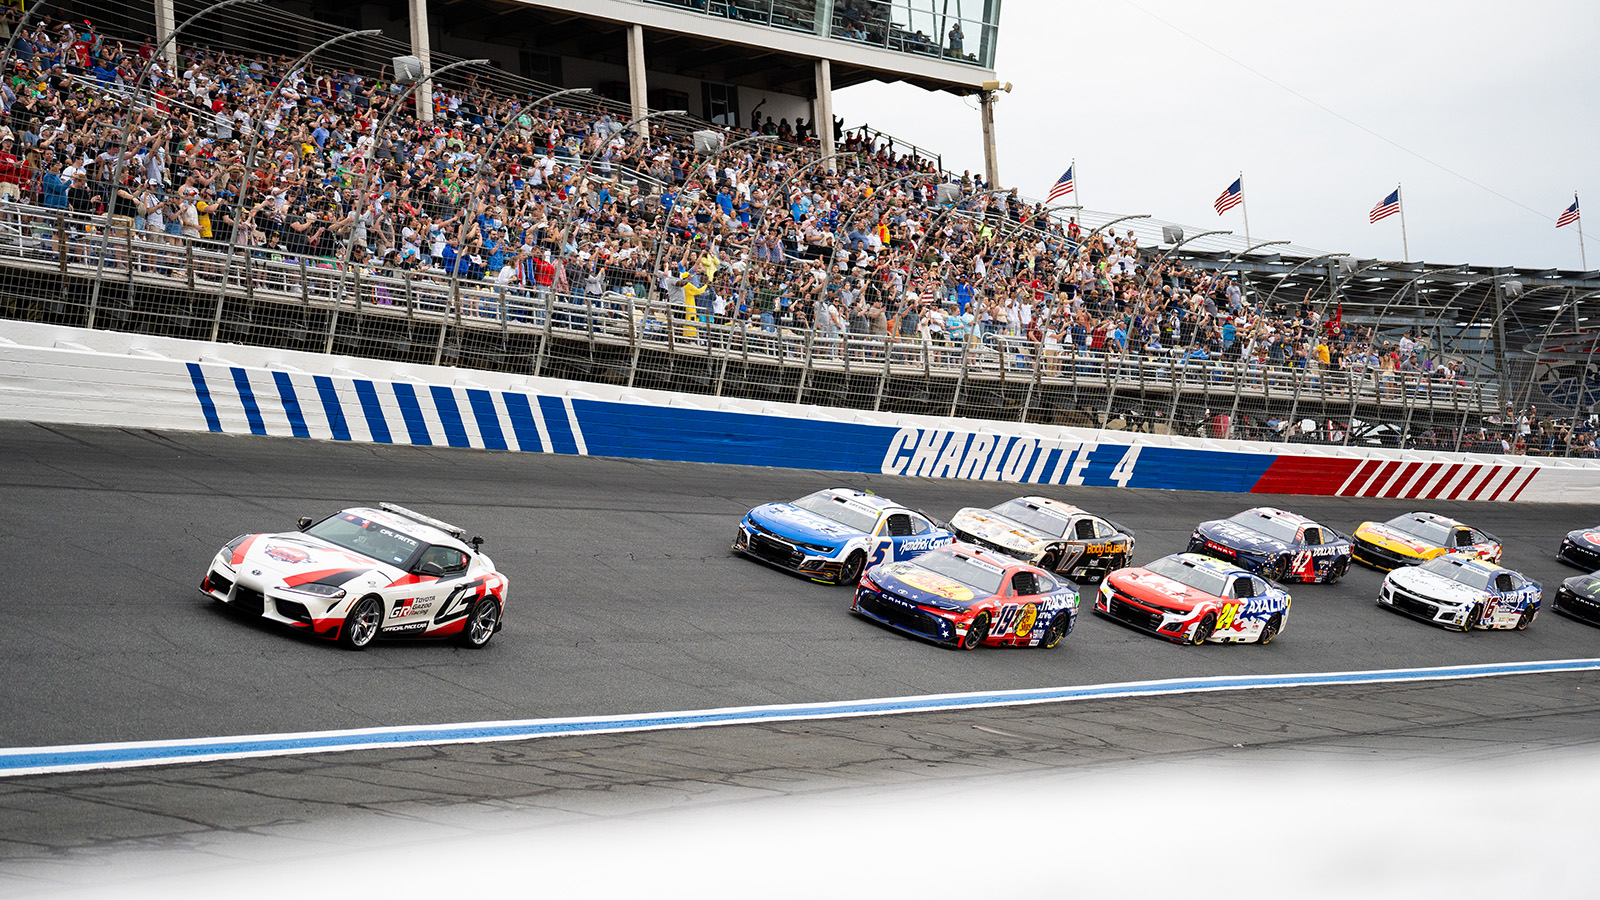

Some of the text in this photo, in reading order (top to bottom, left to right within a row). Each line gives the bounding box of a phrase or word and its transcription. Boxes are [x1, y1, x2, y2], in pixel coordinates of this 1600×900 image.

[881, 427, 1142, 487] CHARLOTTE 4
[379, 528, 418, 546] CPL FRITZ
[865, 541, 893, 571] 5
[1055, 543, 1086, 573] 17
[1086, 541, 1127, 557] Body Guard
[1313, 544, 1350, 557] DOLLAR TREE
[1292, 550, 1312, 573] 42
[412, 602, 433, 610] GAZOO
[415, 595, 436, 603] TOYOTA
[882, 593, 916, 609] CAMRY
[1040, 593, 1075, 611] TRACKER
[1246, 596, 1287, 614] AXALTA
[1483, 597, 1498, 619] 16
[390, 606, 412, 618] GR
[989, 603, 1018, 637] 19
[1215, 602, 1239, 631] 24
